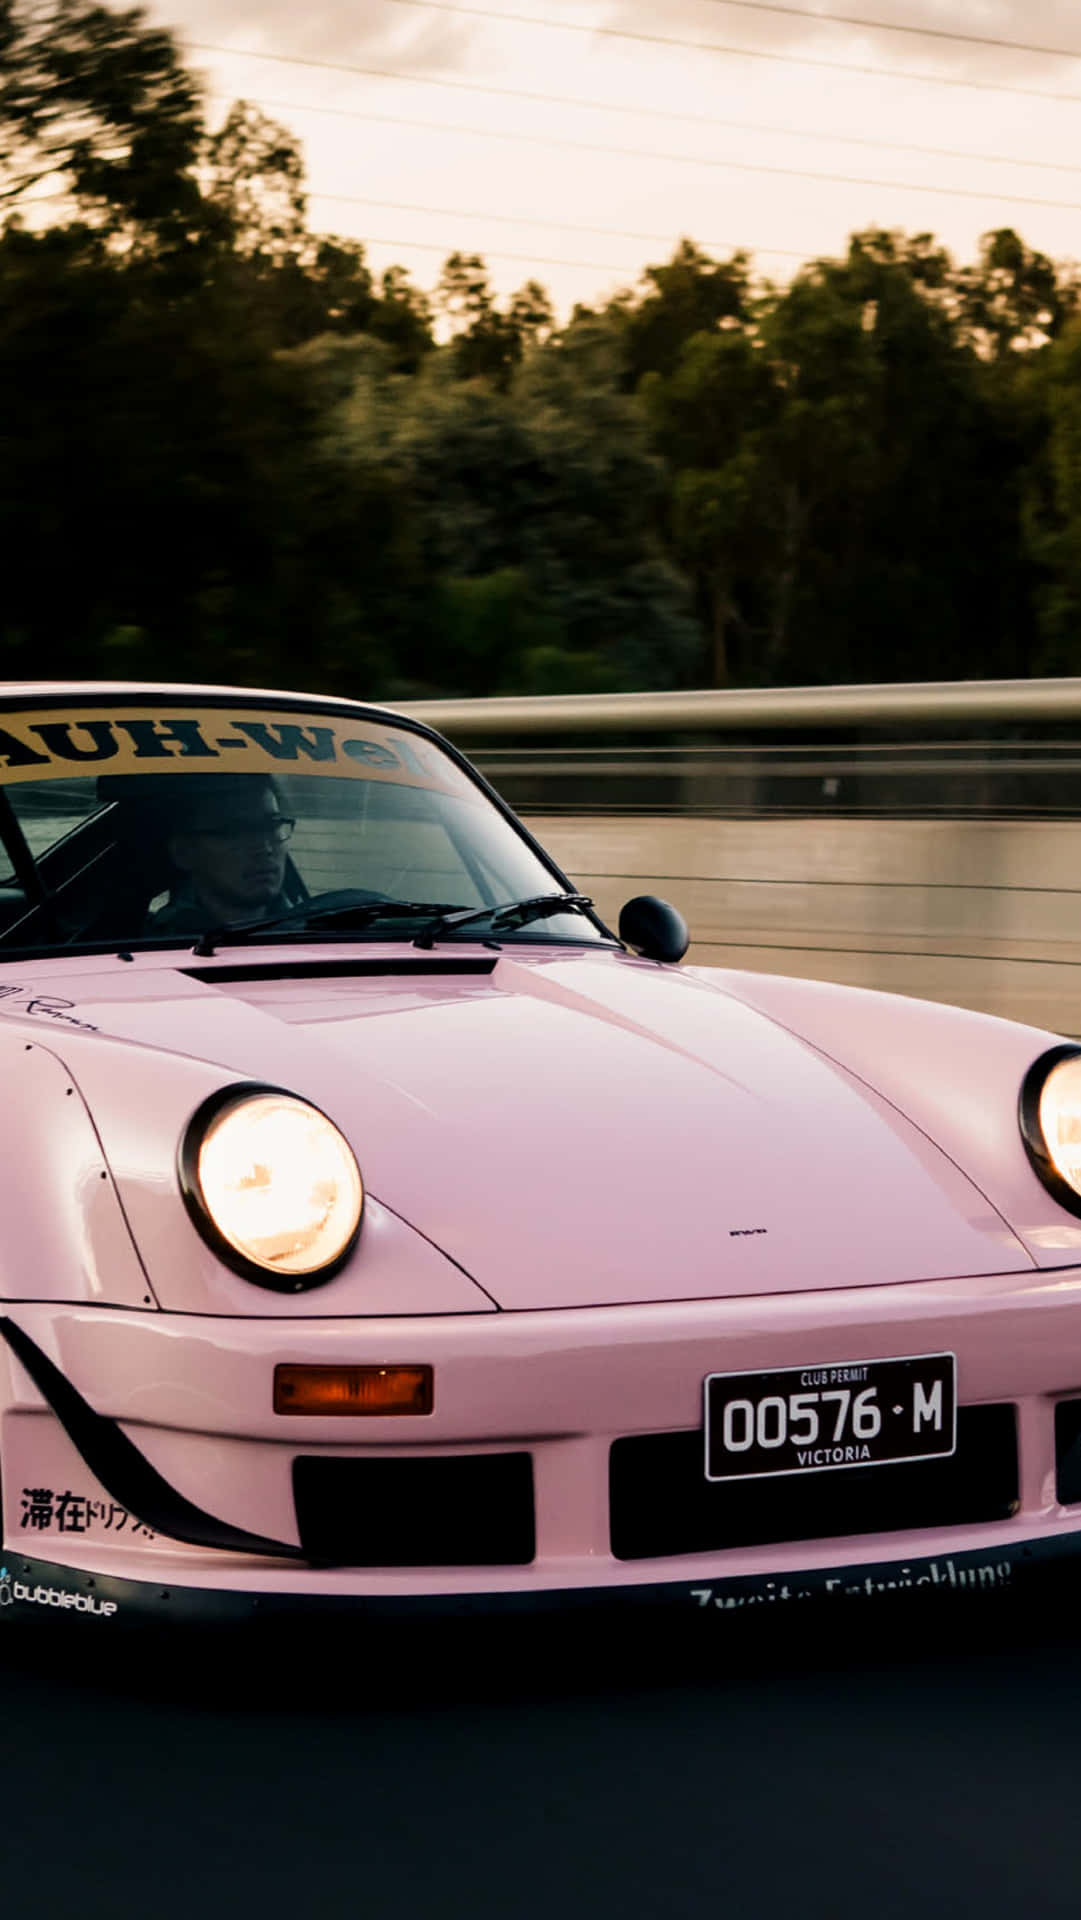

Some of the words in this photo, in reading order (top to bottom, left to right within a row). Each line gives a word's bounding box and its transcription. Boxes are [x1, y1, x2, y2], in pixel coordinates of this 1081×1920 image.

[800, 1371, 828, 1386] CLUB
[830, 1367, 869, 1384] PERMIT
[723, 1386, 881, 1452] 00576
[797, 1445, 871, 1466] VICTORIA
[13, 1581, 118, 1616] bubbleblue
